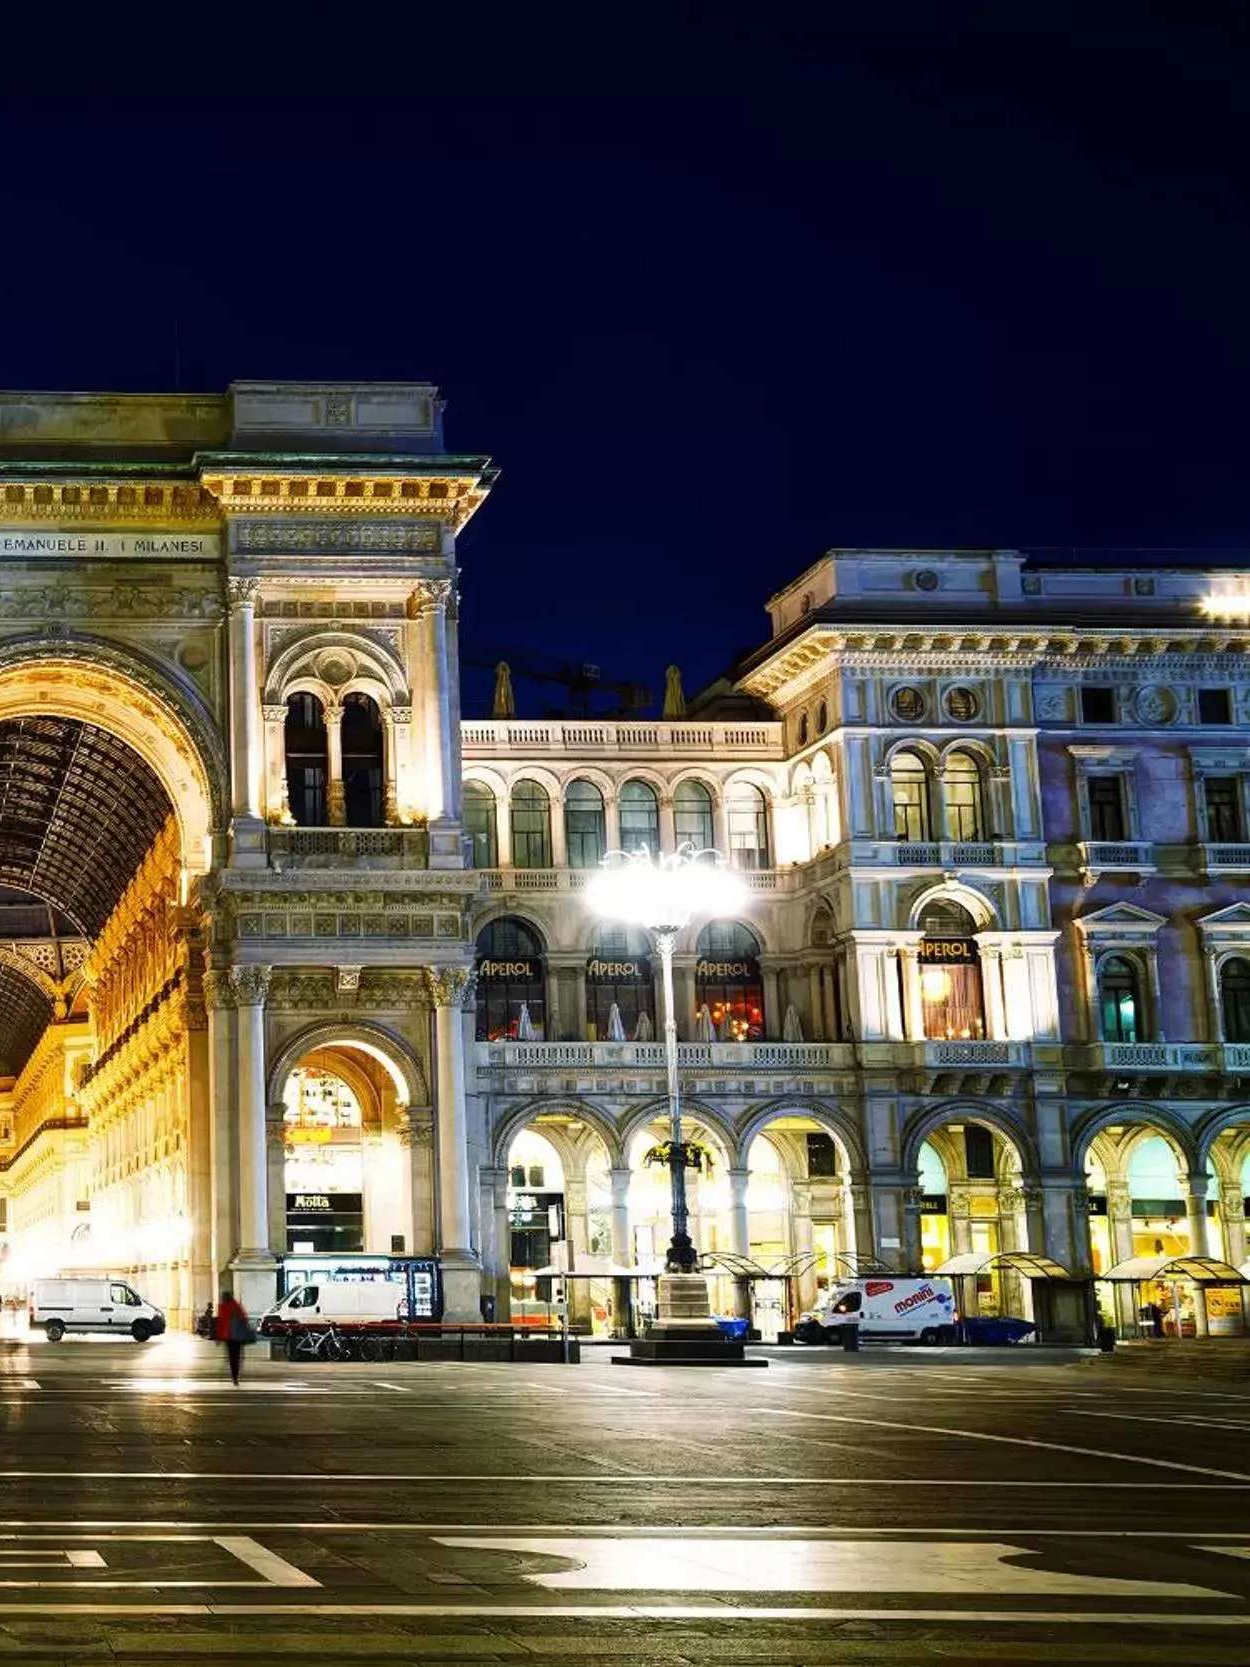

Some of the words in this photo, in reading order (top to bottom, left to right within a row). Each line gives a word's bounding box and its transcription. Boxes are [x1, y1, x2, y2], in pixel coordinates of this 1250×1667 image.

[4, 538, 87, 551] EMANUELE
[134, 540, 203, 553] MILANESI
[479, 960, 534, 976] APEROL
[588, 960, 643, 976] APEROL
[696, 960, 751, 976] APEROL
[294, 1194, 330, 1208] Motta
